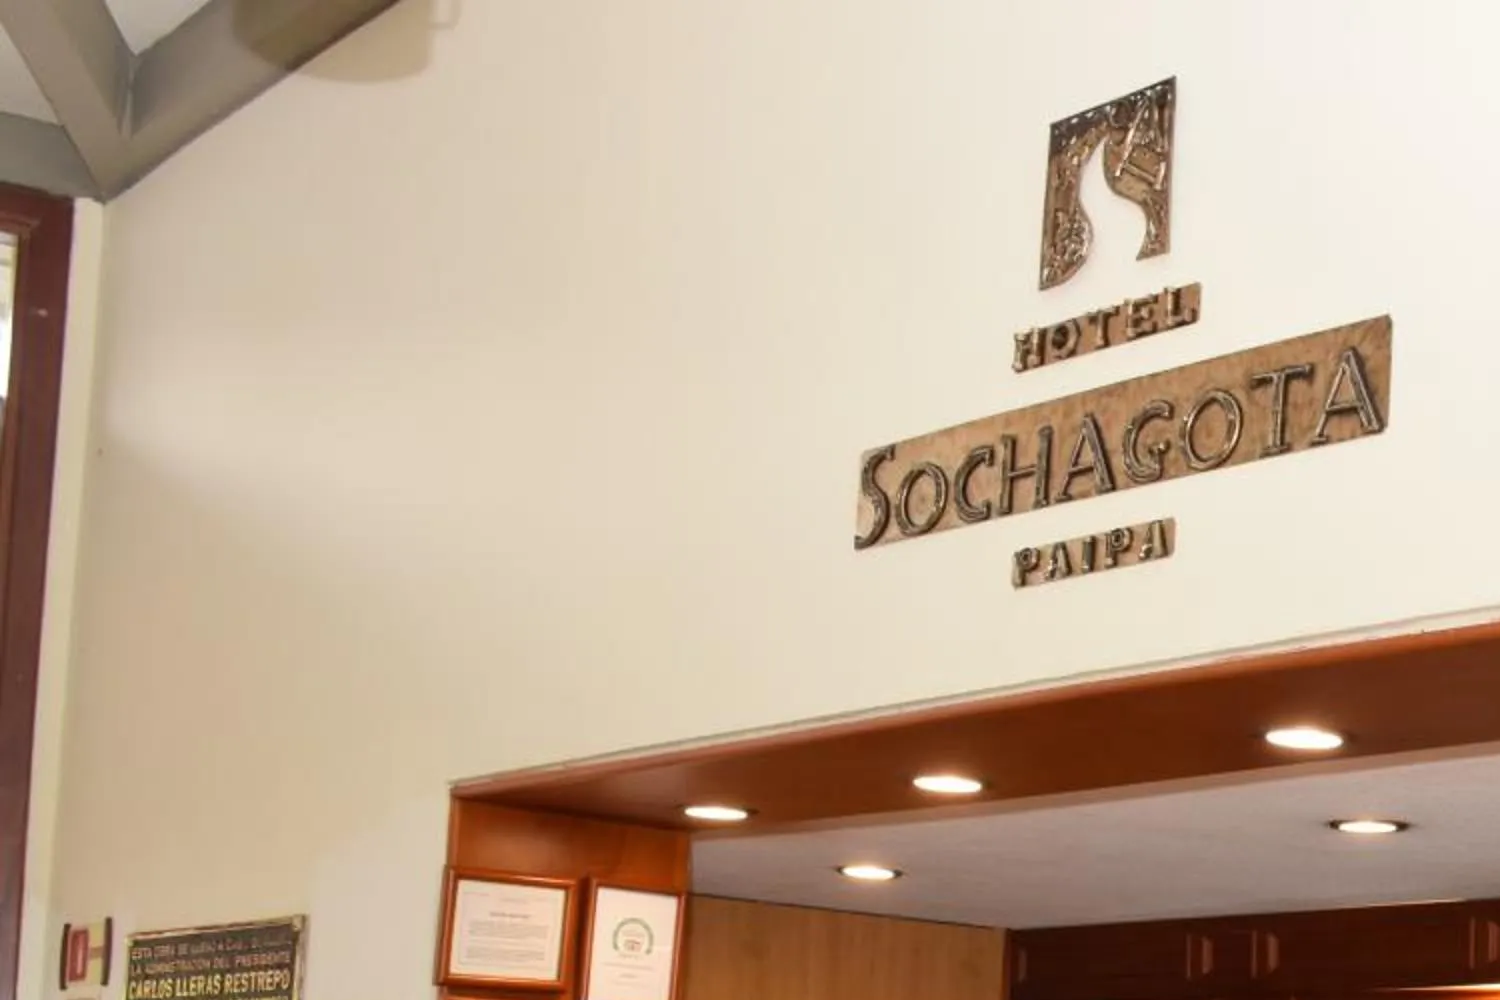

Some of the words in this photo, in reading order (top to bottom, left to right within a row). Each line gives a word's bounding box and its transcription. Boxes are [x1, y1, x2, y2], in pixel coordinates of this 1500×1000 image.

[1012, 286, 1200, 373] HOTEL
[855, 345, 1386, 549] SOCHAGOTA
[1012, 519, 1169, 588] PAIPA
[129, 978, 174, 1000] CARLOS
[175, 973, 222, 997] LLERAS
[223, 969, 290, 994] RESTREPO
